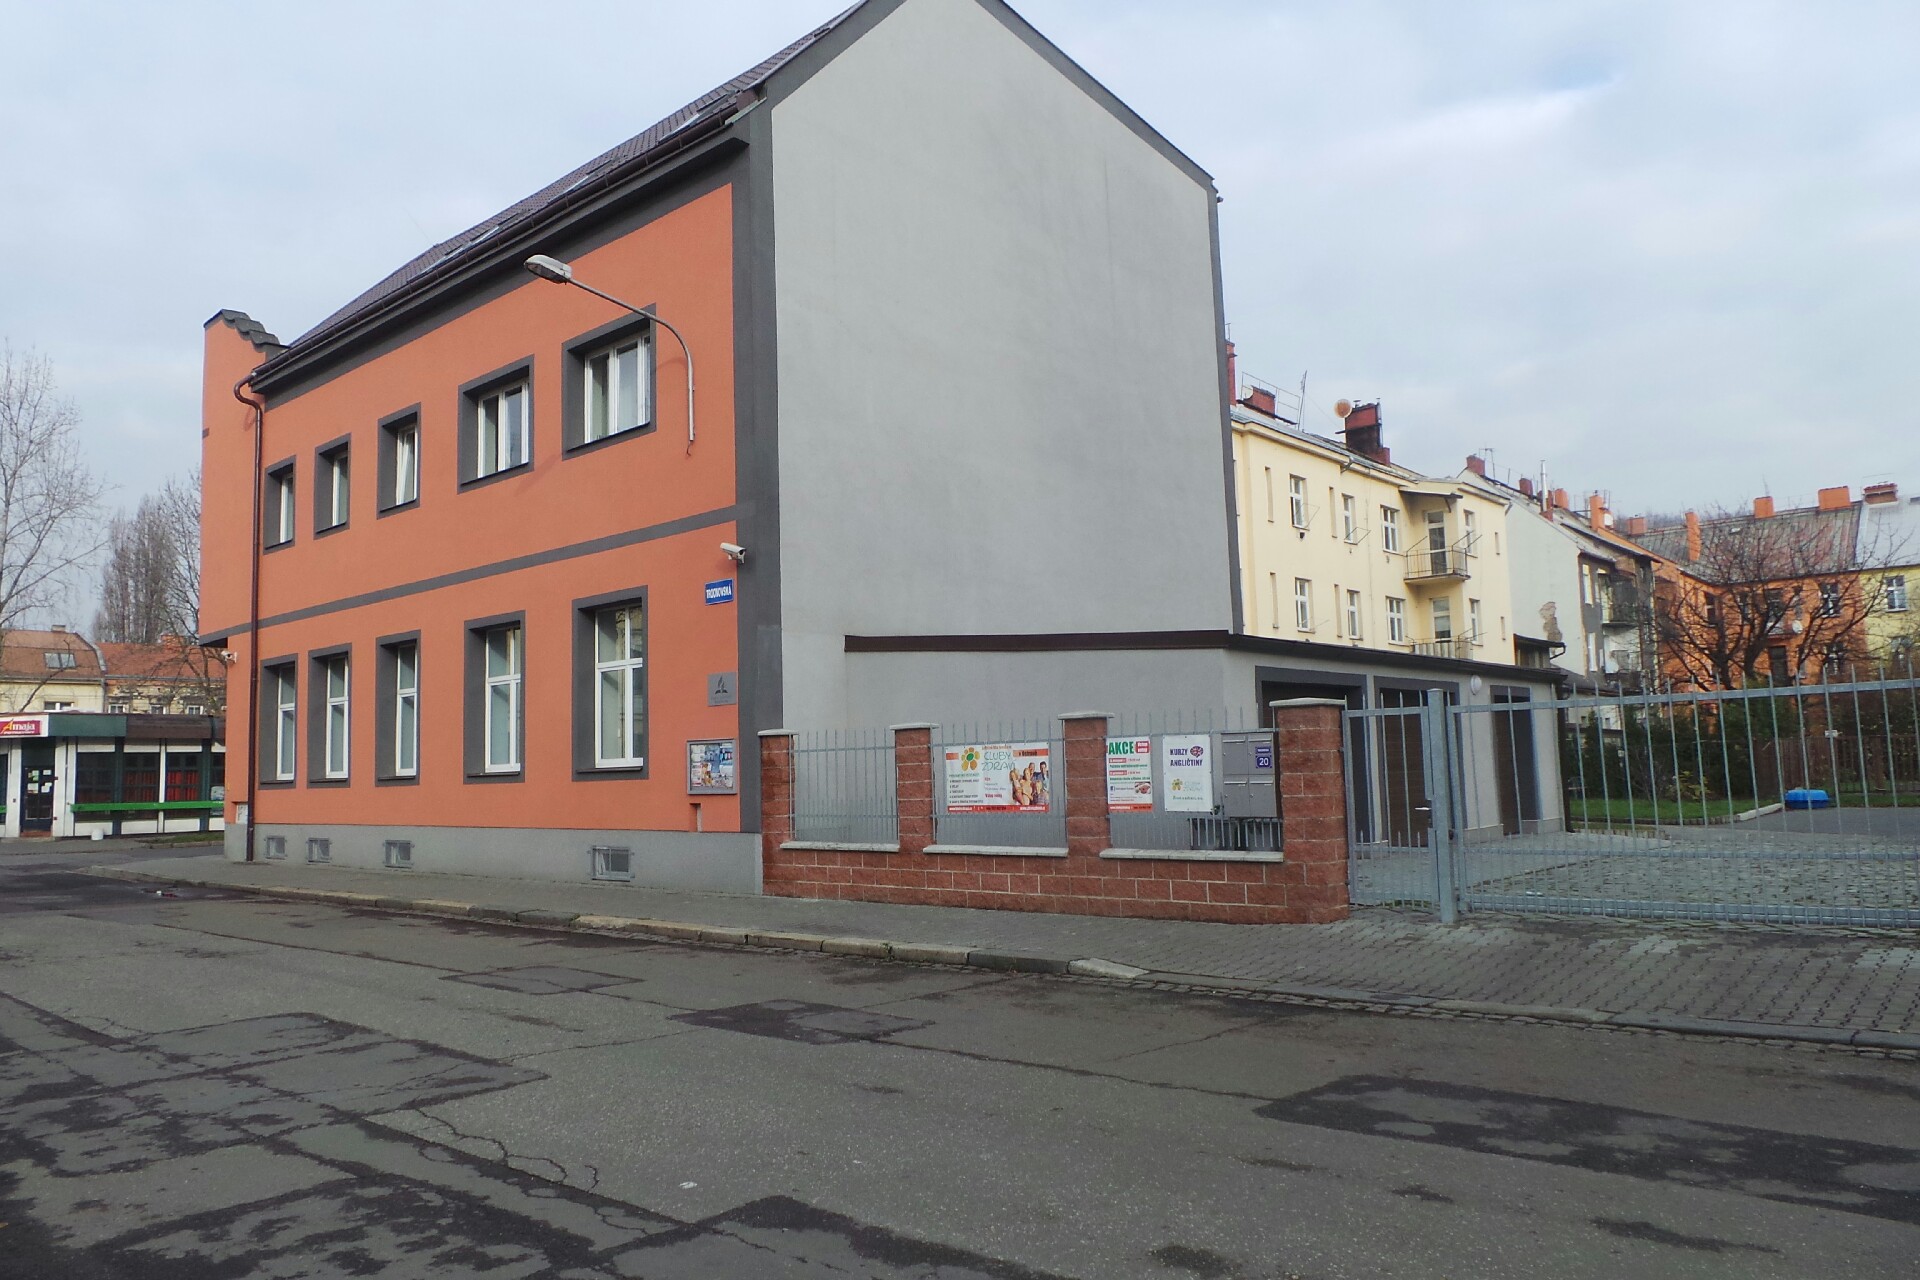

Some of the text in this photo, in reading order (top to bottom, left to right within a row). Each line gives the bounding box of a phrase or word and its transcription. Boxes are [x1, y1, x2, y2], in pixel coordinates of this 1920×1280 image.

[1108, 741, 1135, 755] AKCE
[1169, 748, 1188, 756] KURZY
[1170, 758, 1203, 767] ANGLIČTINY
[1259, 757, 1269, 766] 20
